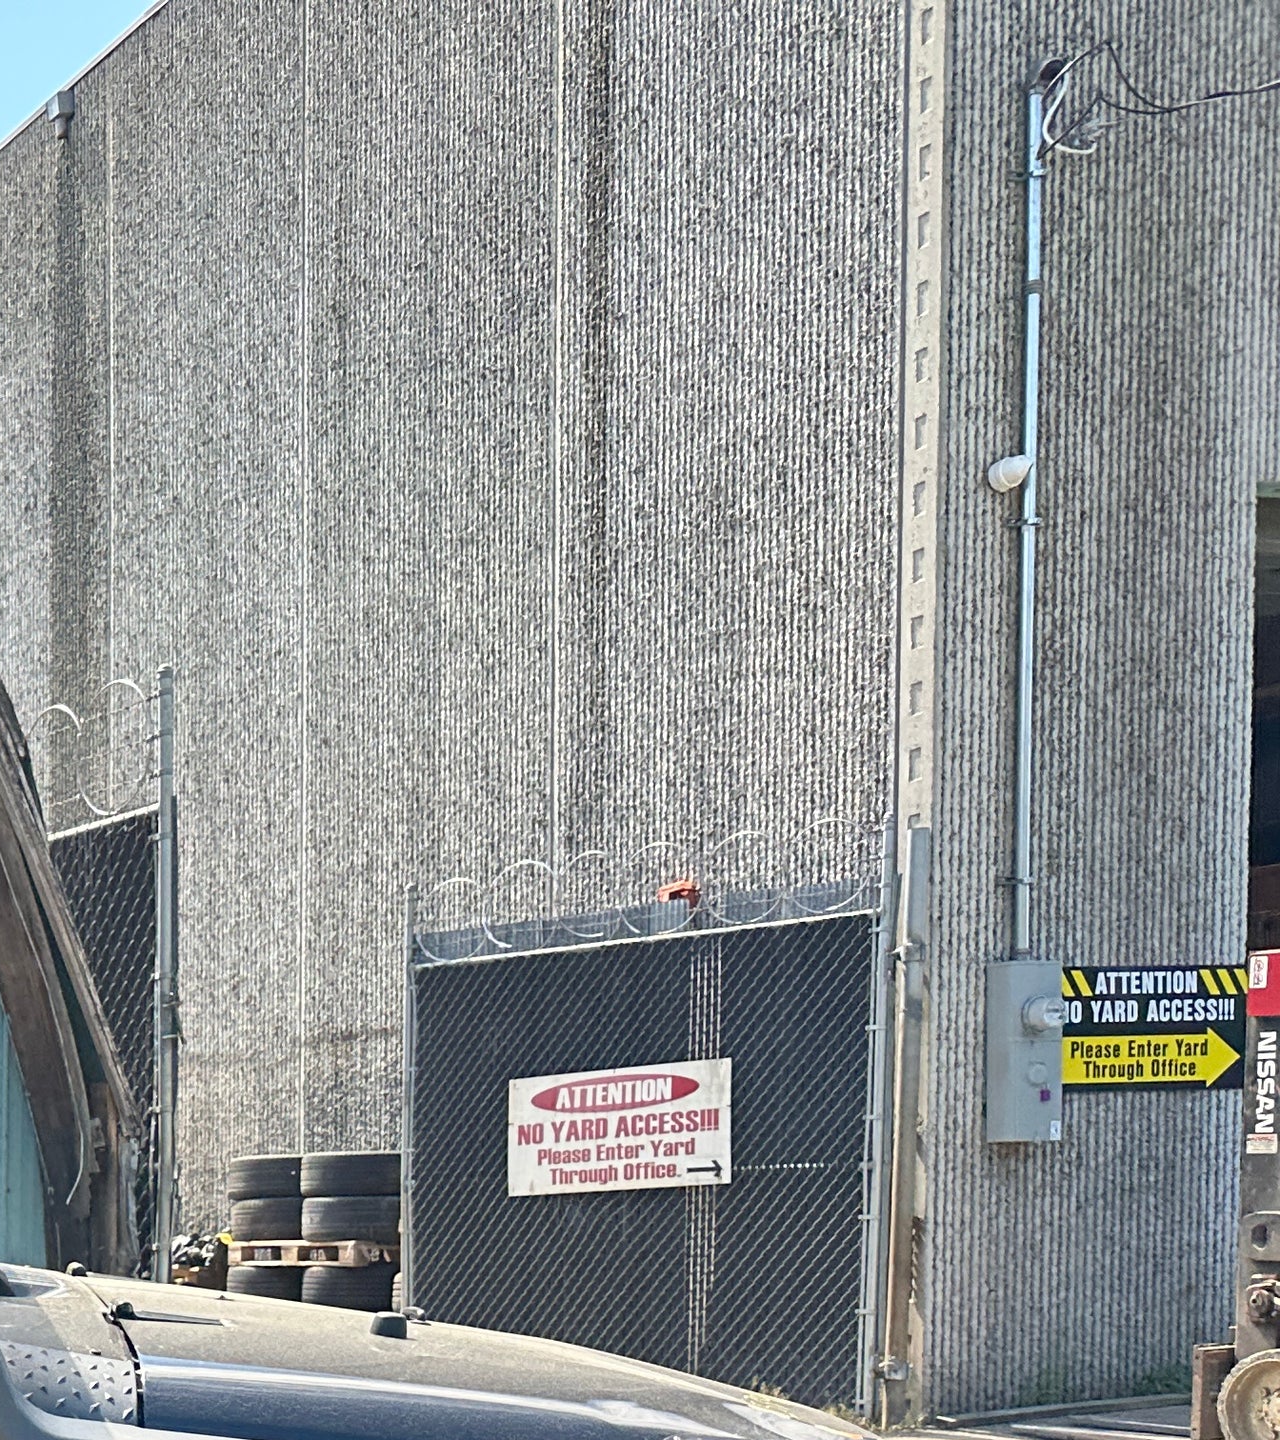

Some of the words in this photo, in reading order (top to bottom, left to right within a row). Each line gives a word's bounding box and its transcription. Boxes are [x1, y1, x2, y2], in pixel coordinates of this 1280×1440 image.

[1095, 971, 1197, 995] ATTENTION
[1090, 1000, 1138, 1023] YARD
[1146, 998, 1235, 1022] ACCESS!!!
[1070, 1041, 1121, 1059] Please
[1128, 1040, 1168, 1058] Enter
[1175, 1039, 1209, 1057] Yard
[1083, 1060, 1144, 1080] Through
[1151, 1059, 1196, 1077] Office
[555, 1077, 673, 1109] ATTENTION
[1255, 1031, 1277, 1134] NISSAN
[518, 1124, 544, 1146] NO
[551, 1117, 608, 1143] YARD
[615, 1109, 720, 1138] ACCESS!!!
[537, 1147, 591, 1166] Please
[596, 1143, 645, 1162] Enter
[650, 1138, 696, 1157] Yard
[550, 1166, 618, 1185] Through
